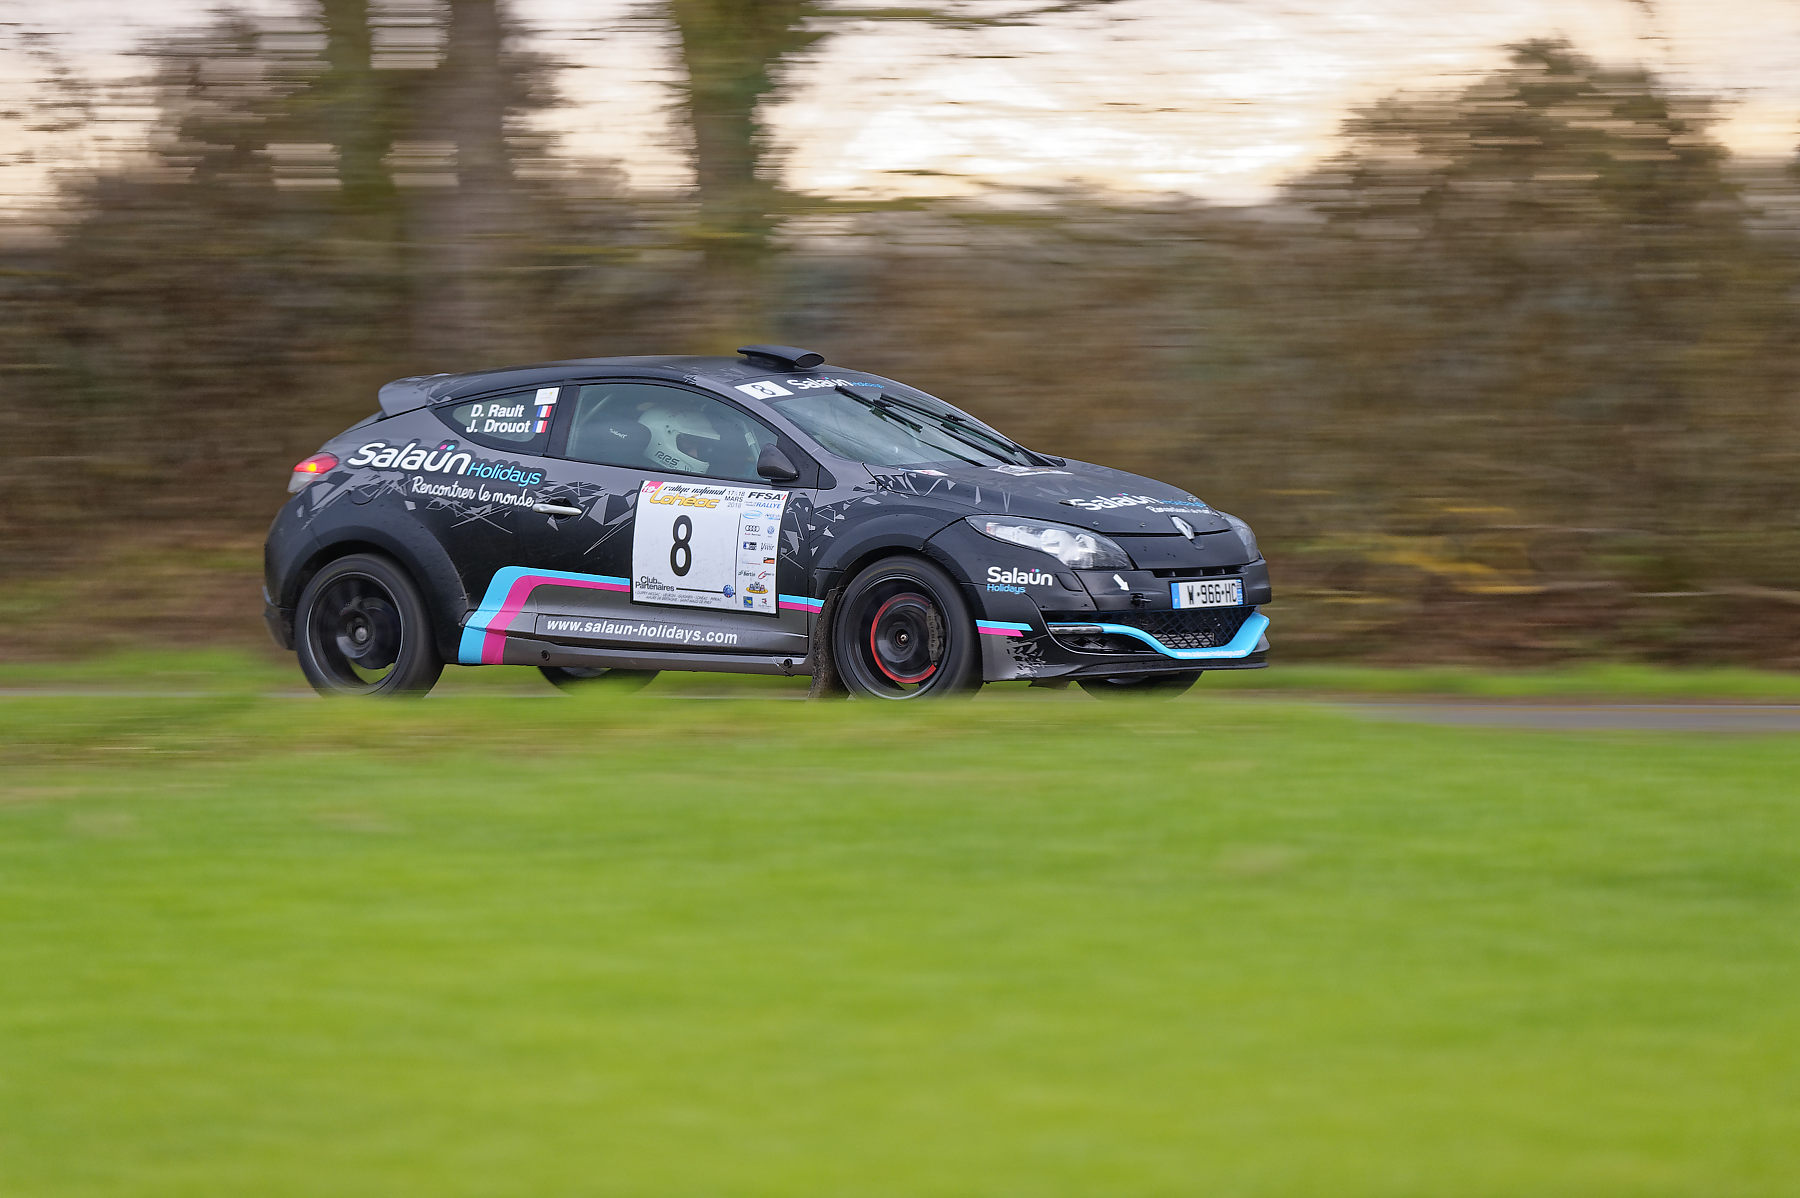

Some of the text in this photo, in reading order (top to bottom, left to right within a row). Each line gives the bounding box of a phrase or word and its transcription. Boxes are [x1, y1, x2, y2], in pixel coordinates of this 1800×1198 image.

[471, 404, 525, 418] D. Rault
[466, 420, 531, 433] J. Drouot
[655, 450, 680, 466] RRS
[467, 462, 542, 487] Holidays
[412, 475, 534, 508] Rencontrer le monde
[748, 491, 781, 501] FFSA
[724, 495, 744, 503] MARS
[670, 514, 692, 577] 8
[635, 581, 675, 592] Partenaires
[640, 575, 658, 585] Club
[987, 584, 1026, 595] Holidays
[547, 619, 738, 645] www.salaun-holidays.com
